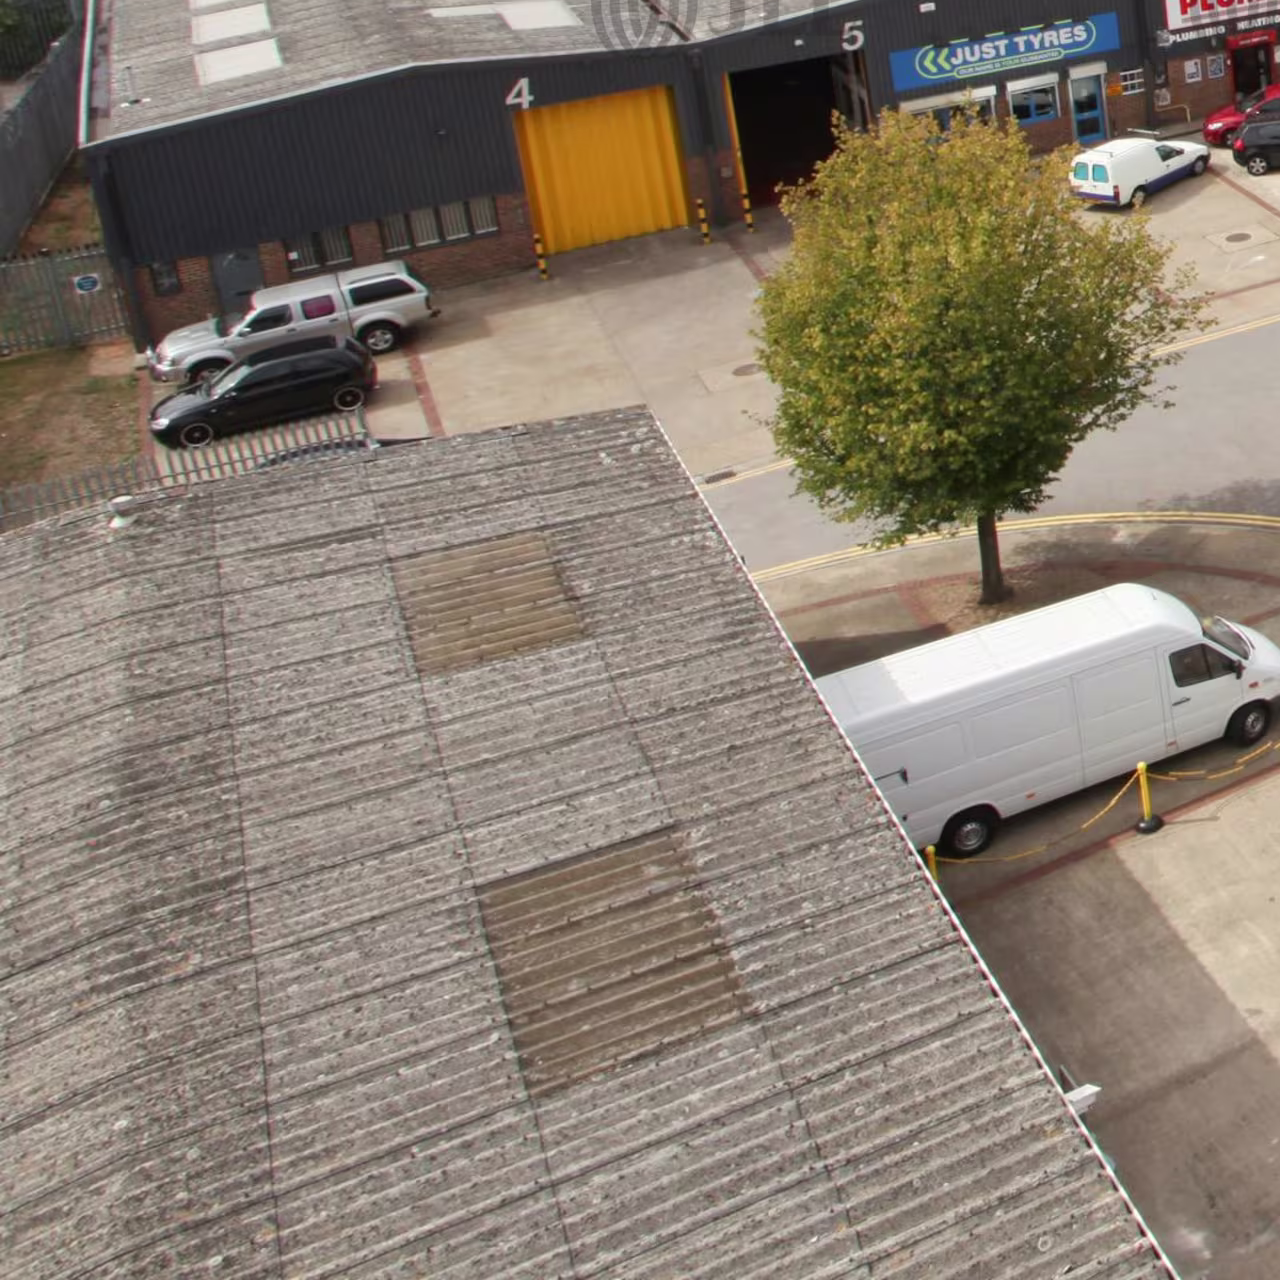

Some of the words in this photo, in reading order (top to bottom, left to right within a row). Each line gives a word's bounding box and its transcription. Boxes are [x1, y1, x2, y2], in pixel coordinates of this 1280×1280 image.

[841, 20, 865, 51] 5
[950, 39, 1009, 65] JUST
[1013, 24, 1087, 52] TYRES
[1169, 25, 1226, 44] PLUMBING
[505, 77, 535, 109] 4
